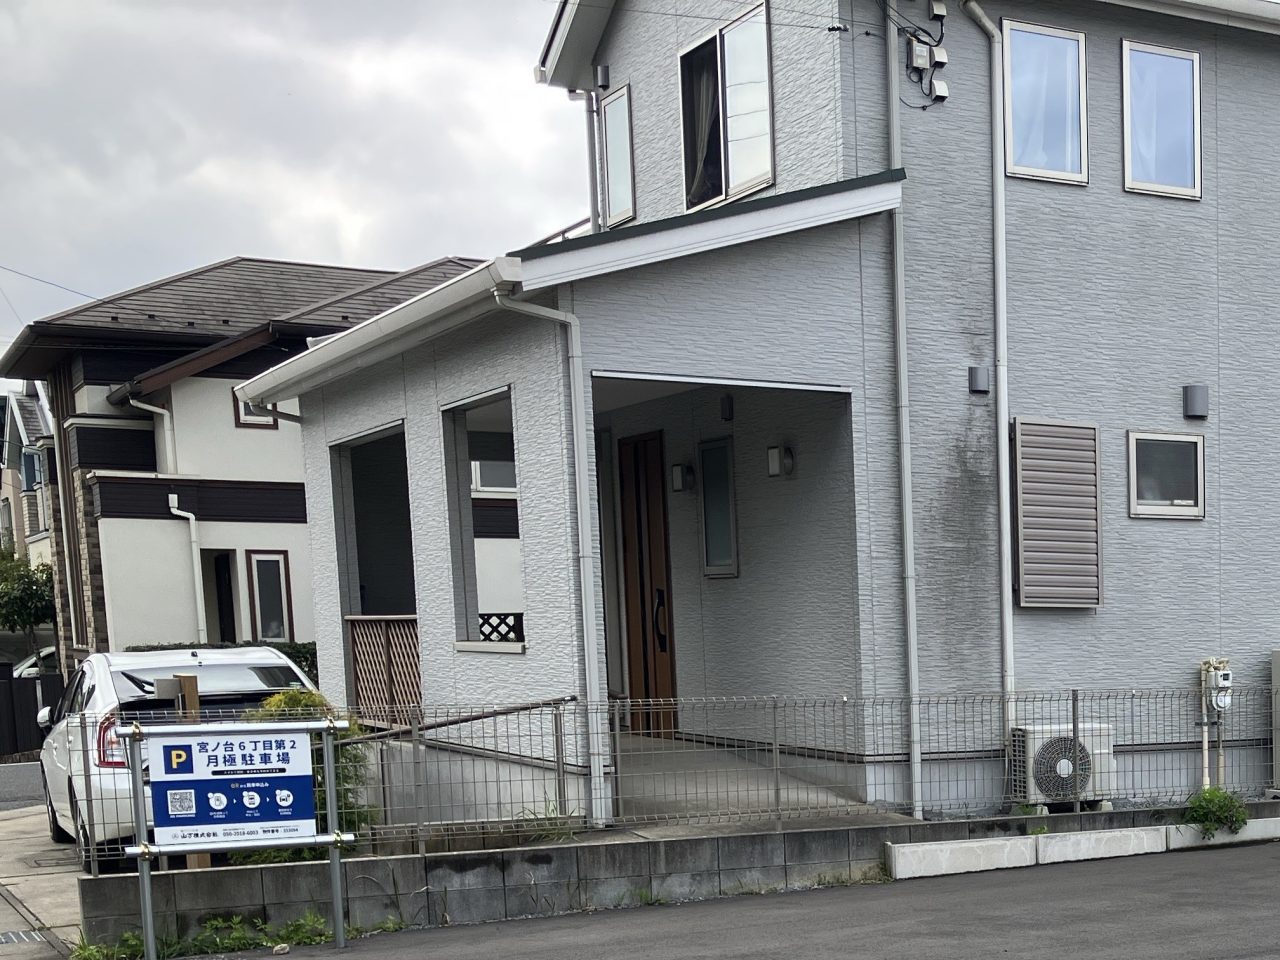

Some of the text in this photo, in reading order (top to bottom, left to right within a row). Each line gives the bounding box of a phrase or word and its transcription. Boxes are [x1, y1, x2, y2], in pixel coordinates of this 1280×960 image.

[196, 739, 297, 753] 宮ノ台6丁目第2
[171, 750, 187, 769] P
[206, 752, 291, 767] 月極駐車場
